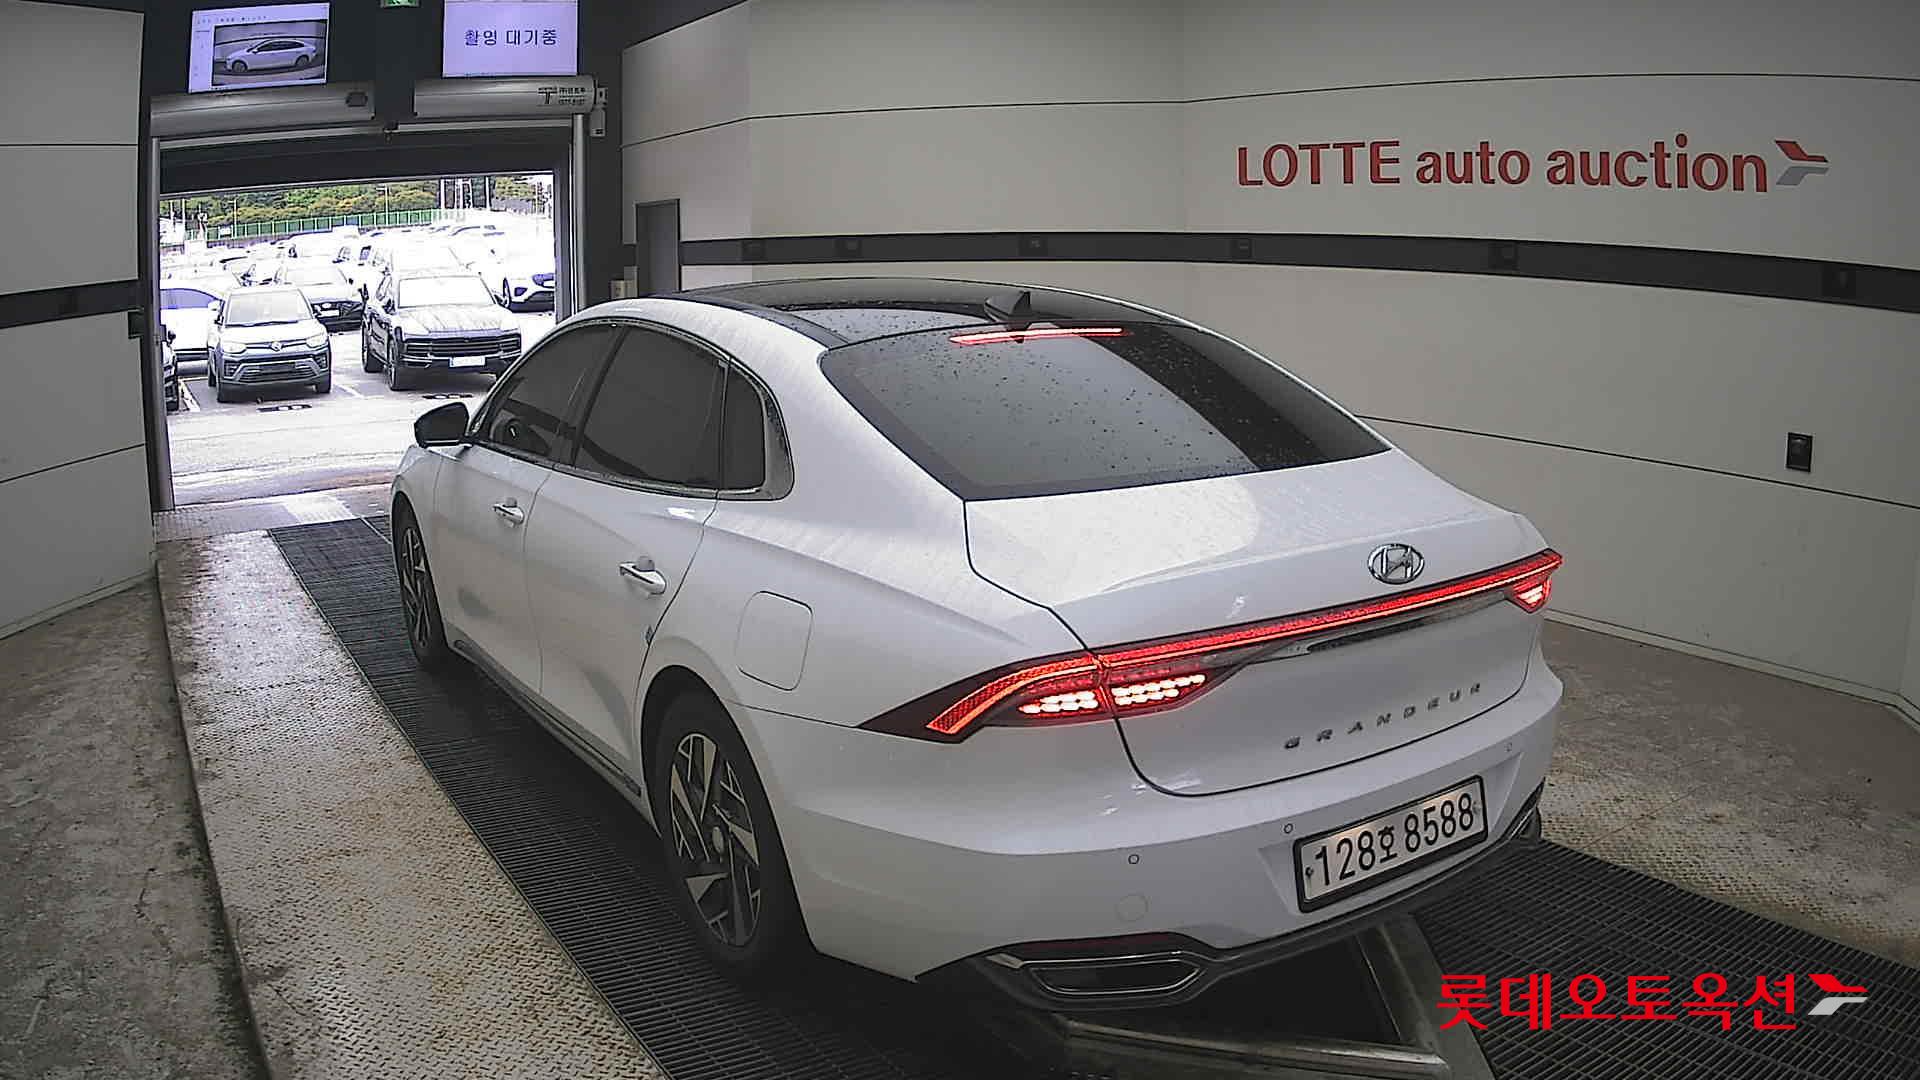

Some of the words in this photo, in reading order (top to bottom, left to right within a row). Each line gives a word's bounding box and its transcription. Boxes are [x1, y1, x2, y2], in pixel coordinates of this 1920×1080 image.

[465, 29, 498, 46] 촬영
[506, 29, 558, 46] 대기중
[1237, 140, 1400, 188] LOTTE
[1416, 141, 1531, 185] auto
[1546, 133, 1767, 193] auction
[1284, 683, 1481, 750] GRANDEUR
